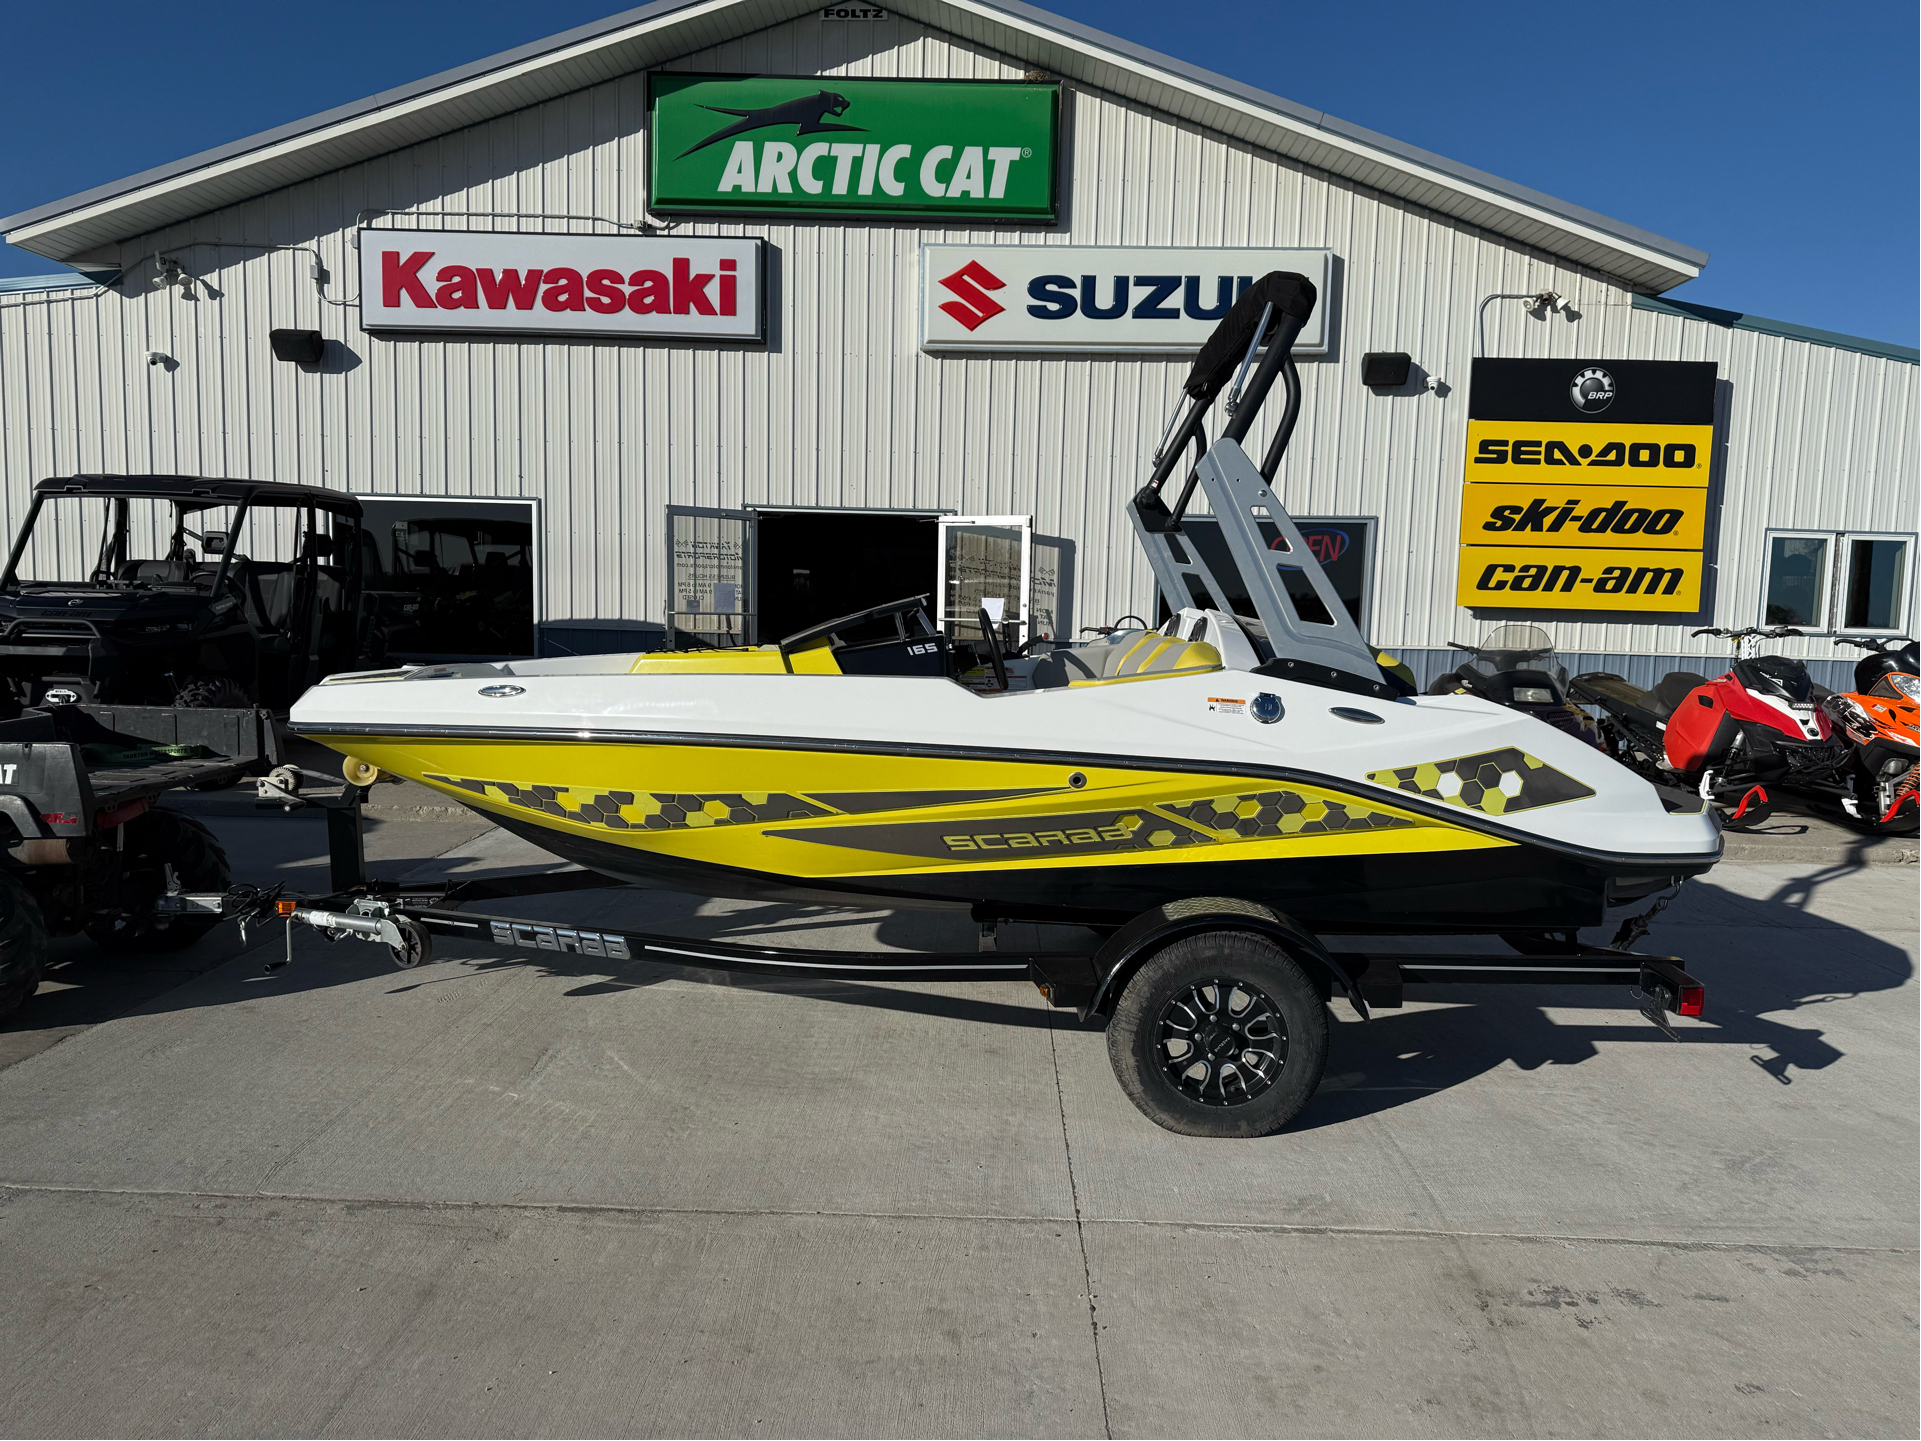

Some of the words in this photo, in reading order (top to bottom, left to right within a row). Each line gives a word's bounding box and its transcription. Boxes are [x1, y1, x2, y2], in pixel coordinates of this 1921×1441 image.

[824, 8, 883, 19] FOLTZ
[717, 141, 912, 196] ARCTIC
[381, 251, 737, 316] Kawasaki
[1026, 274, 1253, 321] SUZU
[1587, 391, 1613, 400] BRP
[1482, 498, 1685, 536] ski-doo
[1476, 563, 1685, 596] can-am
[906, 642, 938, 656] 165
